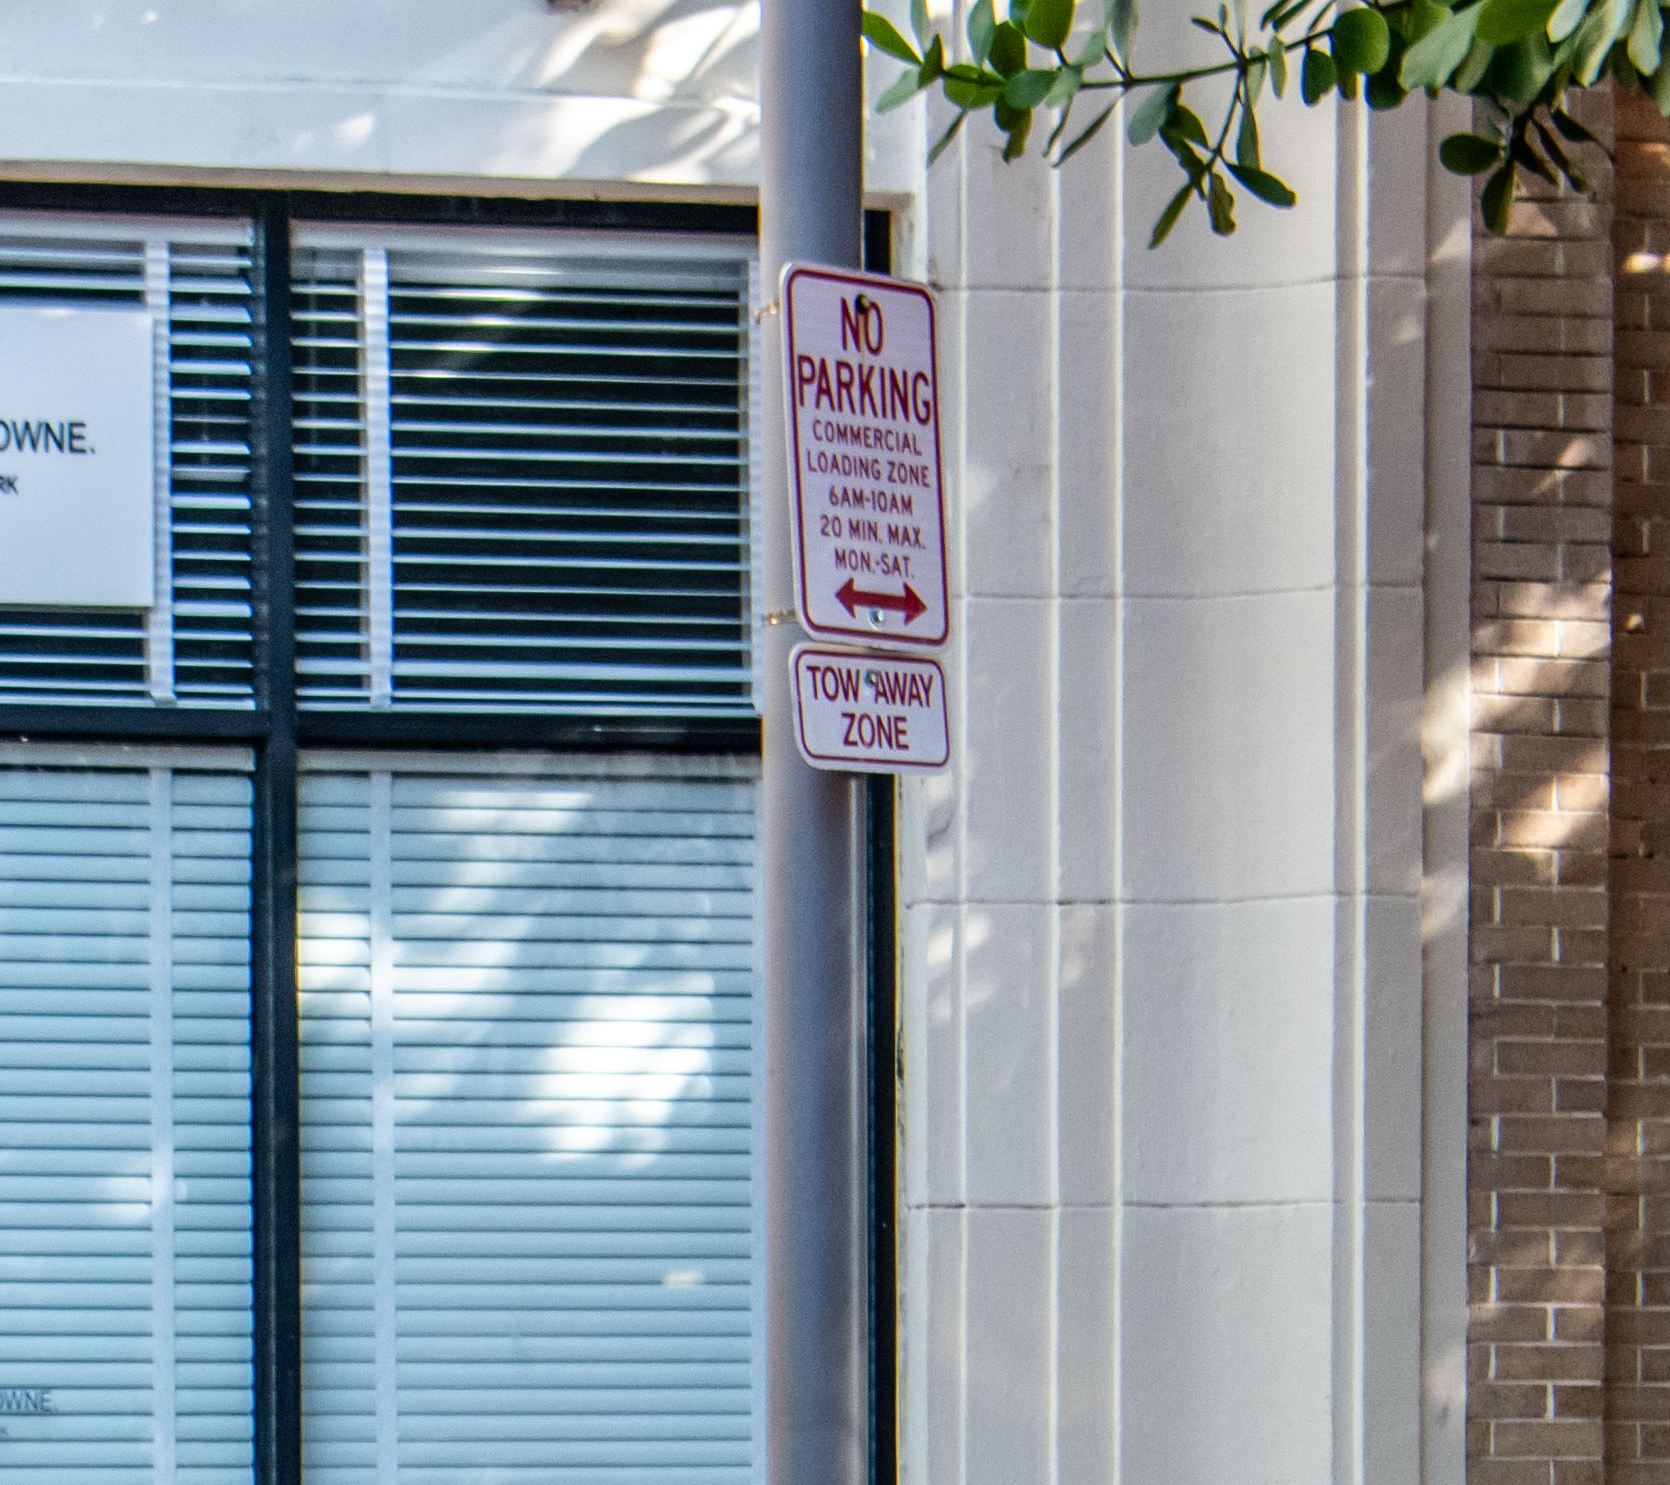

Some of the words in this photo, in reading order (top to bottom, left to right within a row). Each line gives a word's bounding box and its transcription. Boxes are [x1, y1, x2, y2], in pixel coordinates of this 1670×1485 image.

[841, 296, 885, 357] NO
[797, 354, 933, 426] PARKING
[812, 419, 923, 457] COMMERCIAL
[807, 448, 881, 480] LOADING
[888, 458, 931, 488] ZONE
[829, 486, 914, 516] 6AM-10AM
[820, 515, 843, 538] 20
[849, 518, 884, 545] MIN.
[889, 523, 927, 550] MAX.
[806, 666, 861, 703] TOW
[875, 671, 934, 708] AWAY
[841, 711, 910, 751] ZONE
